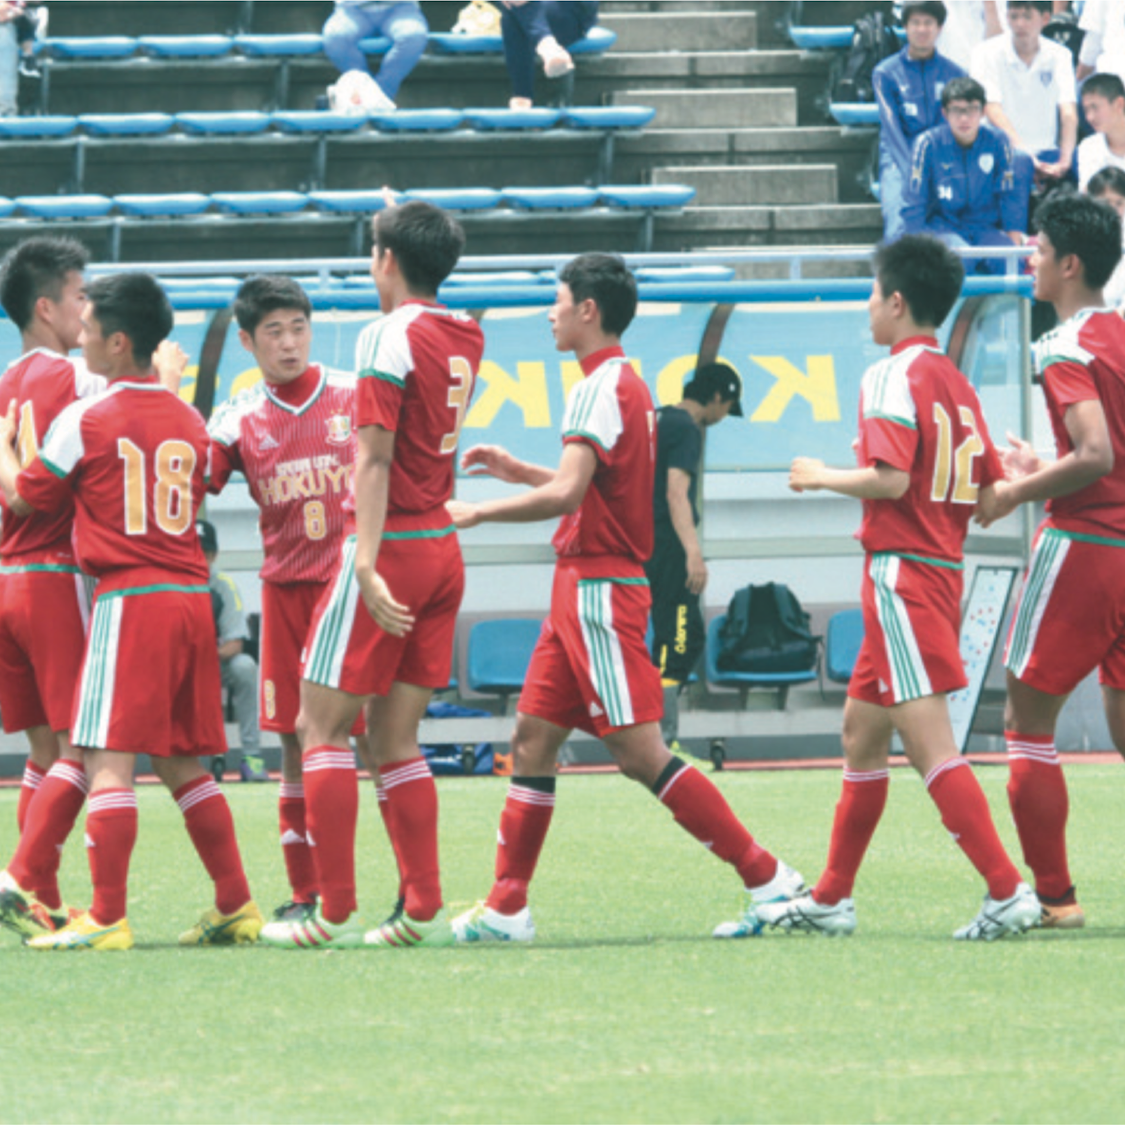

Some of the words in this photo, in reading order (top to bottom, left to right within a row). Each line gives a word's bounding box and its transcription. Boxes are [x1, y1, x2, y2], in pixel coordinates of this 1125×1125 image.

[440, 355, 472, 455] 3
[930, 402, 985, 505] 12
[117, 437, 197, 536] 18
[303, 500, 327, 540] 8
